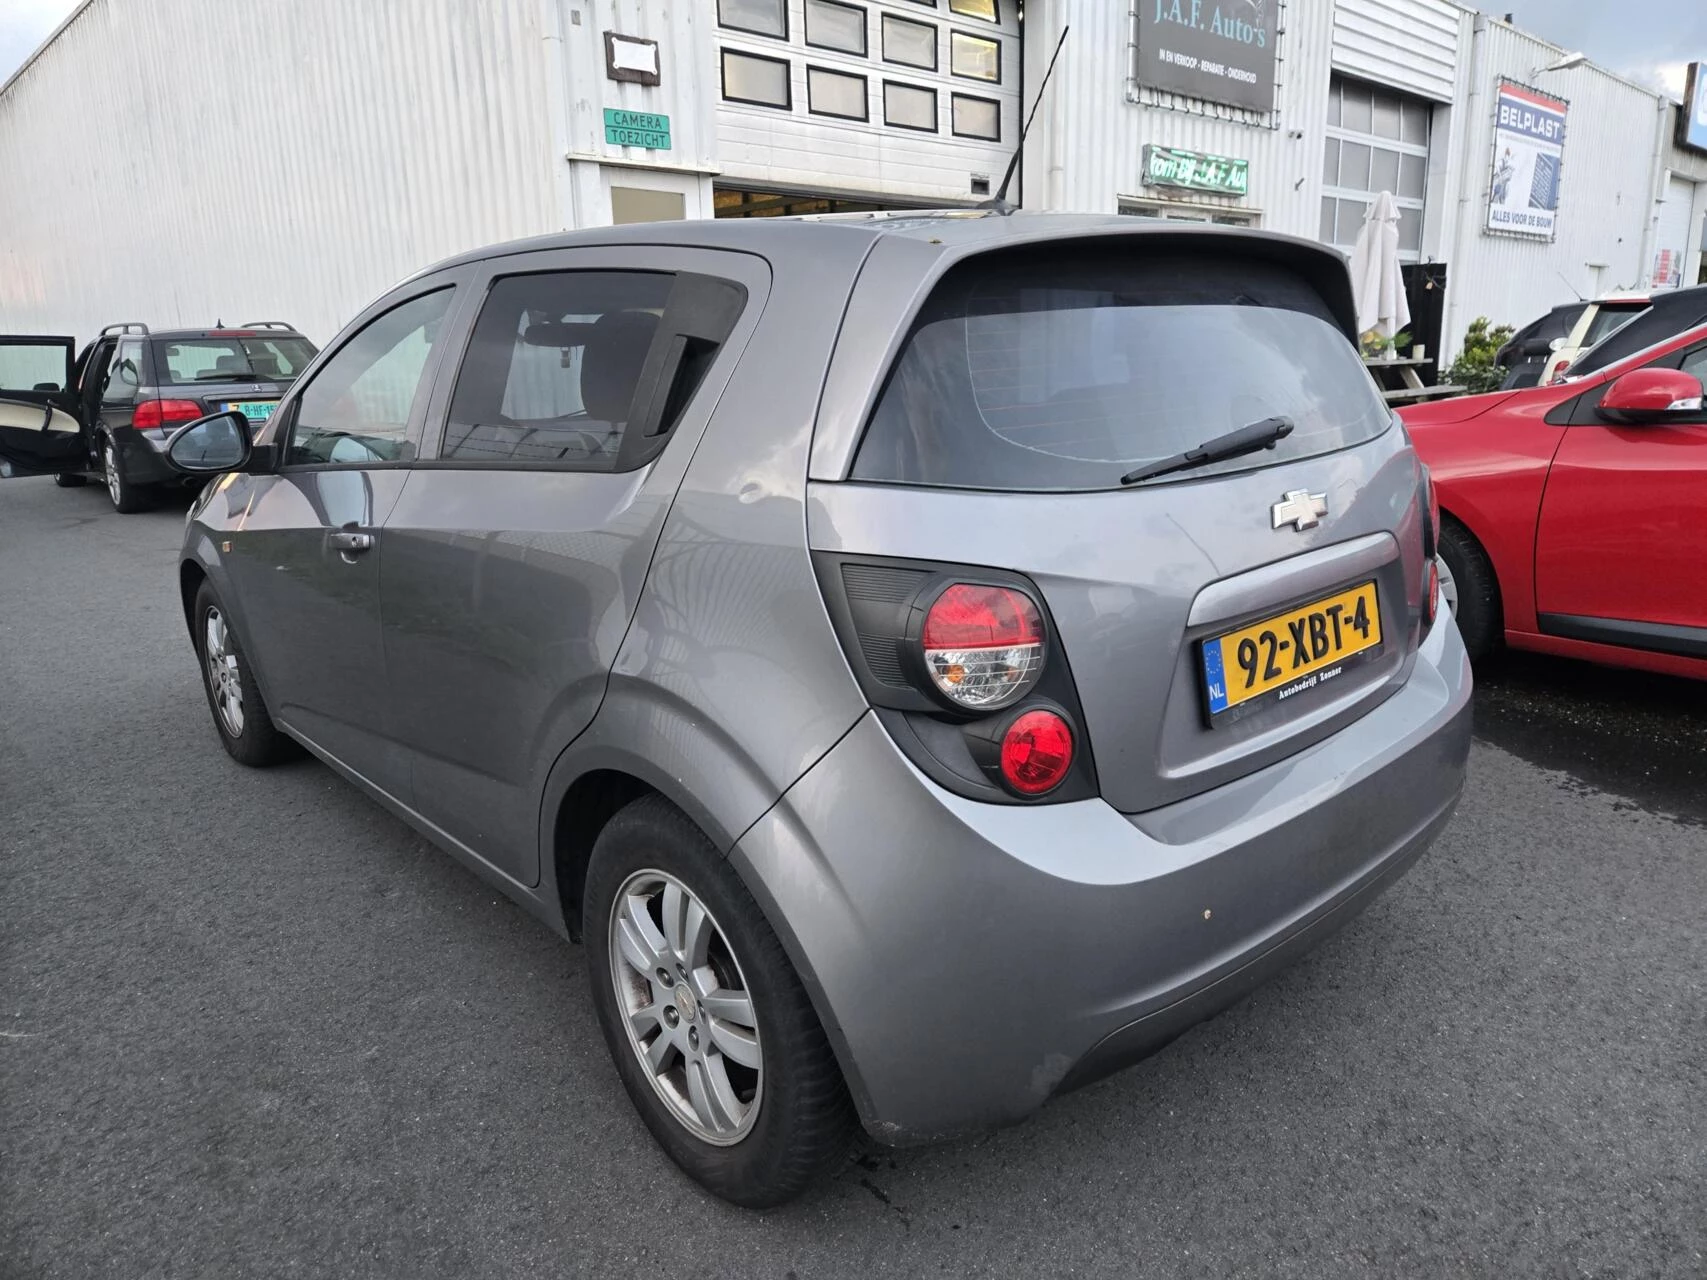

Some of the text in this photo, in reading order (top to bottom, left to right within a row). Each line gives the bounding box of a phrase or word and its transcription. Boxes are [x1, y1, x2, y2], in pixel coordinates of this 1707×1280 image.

[1210, 5, 1265, 48] Auto's
[1174, 51, 1198, 69] VERKOOP
[1228, 67, 1257, 84] ONDERHOUD
[613, 111, 662, 129] CAMERA
[1500, 104, 1560, 139] BELPLAST
[611, 129, 666, 147] TOEZICHT
[1492, 209, 1553, 229] ALLES VOOR DE BOUW
[1237, 595, 1371, 689] 92-XBT-4
[1209, 682, 1225, 701] NL
[1279, 675, 1317, 700] Autobedrijf
